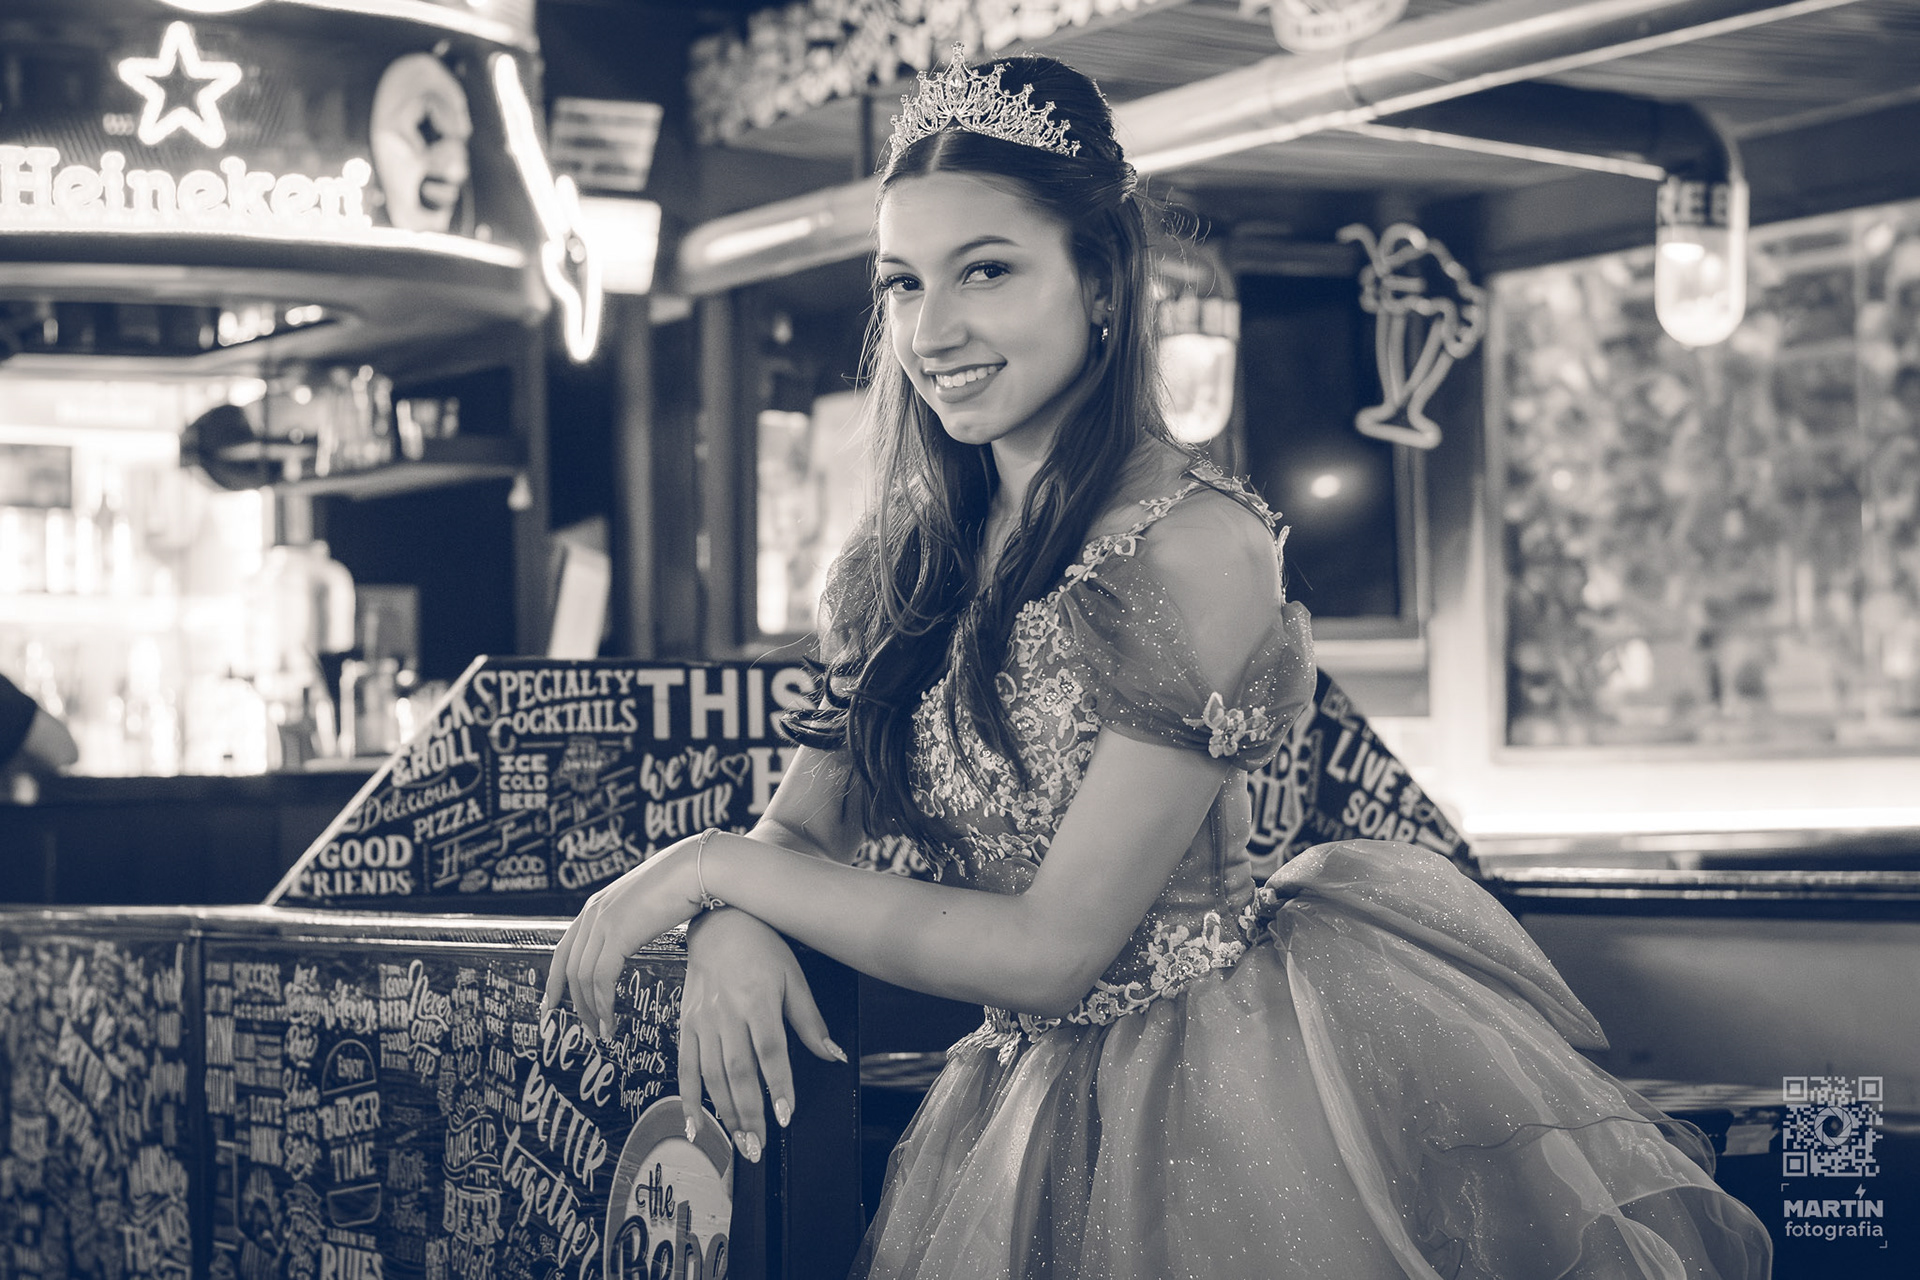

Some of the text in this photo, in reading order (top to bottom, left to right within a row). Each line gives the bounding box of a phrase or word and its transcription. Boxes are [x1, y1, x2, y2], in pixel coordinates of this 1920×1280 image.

[0, 146, 371, 222] Heineken
[474, 668, 635, 726] SPECIALTY
[490, 699, 638, 752] COCKTAILS
[500, 754, 548, 772] ICE
[500, 775, 548, 791] COLD
[640, 745, 719, 799] We're
[1326, 730, 1408, 803] LIVE
[413, 798, 484, 843] PIZZA
[500, 793, 548, 810] BEER
[320, 835, 413, 869] GOOD
[290, 868, 412, 896] FRIENDS
[407, 959, 453, 1032] Never
[512, 1021, 538, 1055] GREAT
[318, 1091, 381, 1140] BURGER
[330, 1141, 377, 1182] TIME
[445, 1123, 479, 1167] WAKE
[443, 1179, 504, 1246] BEER
[635, 1162, 675, 1220] the
